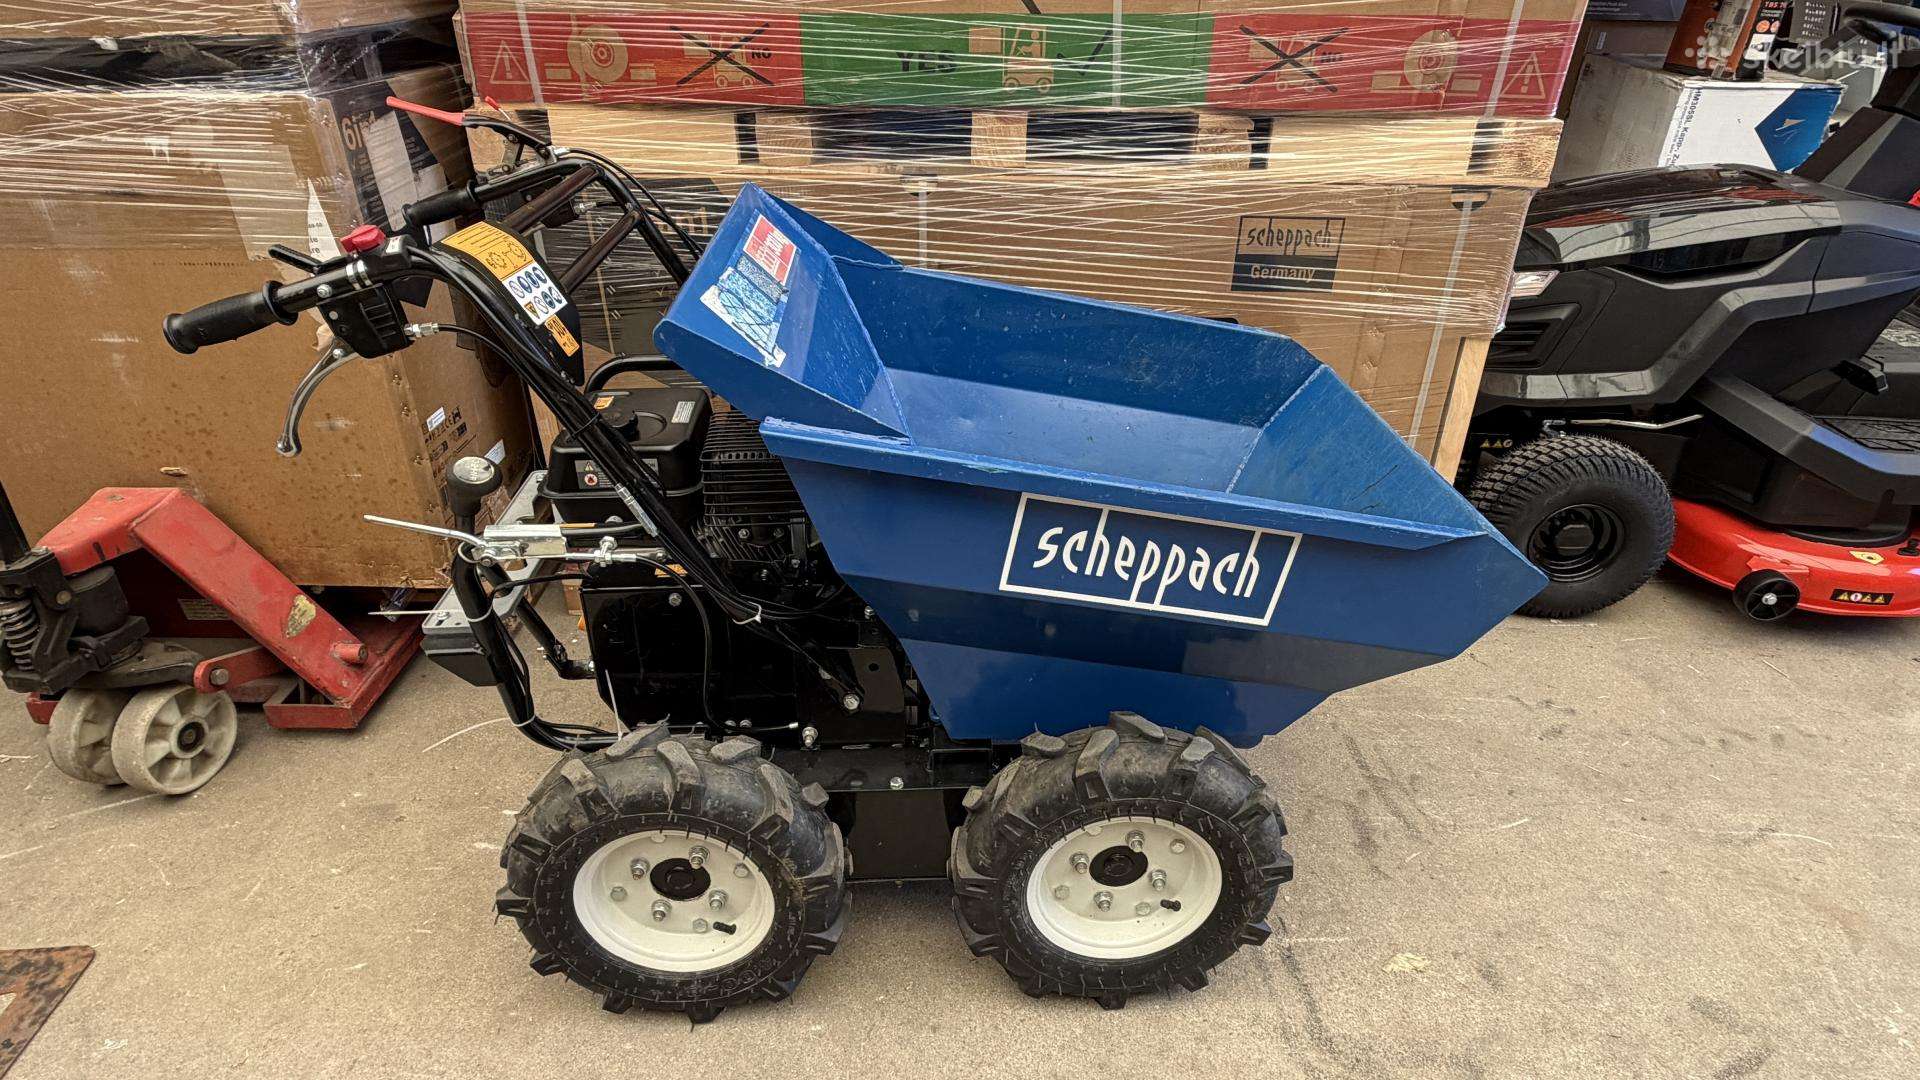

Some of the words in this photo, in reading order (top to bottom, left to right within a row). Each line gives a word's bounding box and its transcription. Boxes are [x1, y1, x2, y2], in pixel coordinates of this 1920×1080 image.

[750, 48, 772, 59] NO
[895, 50, 956, 72] YES
[1246, 218, 1332, 256] scheppach
[1250, 264, 1316, 283] Germany
[1032, 508, 1260, 608] scheppach
